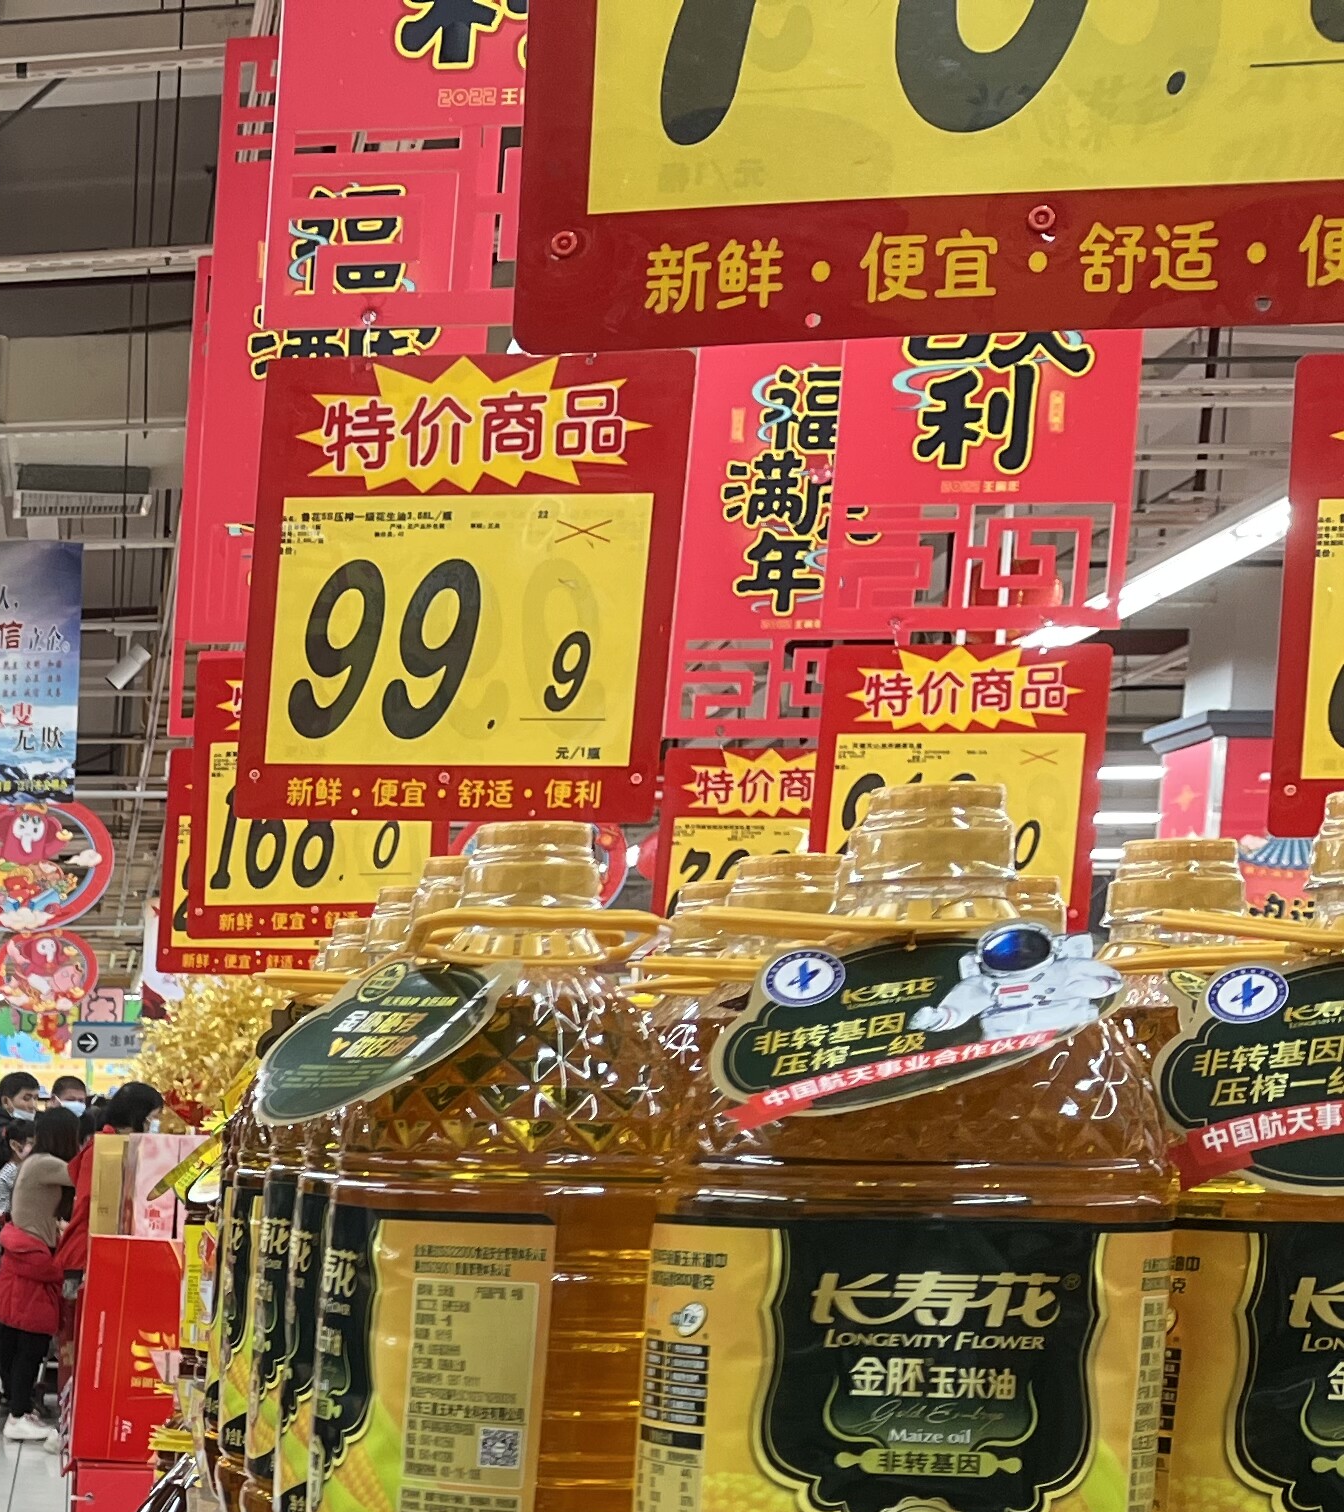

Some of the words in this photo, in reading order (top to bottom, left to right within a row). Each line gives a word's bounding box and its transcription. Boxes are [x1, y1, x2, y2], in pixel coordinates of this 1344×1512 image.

[438, 87, 497, 108] 2022
[501, 87, 526, 106] 壬
[321, 386, 627, 472] 特价商品
[863, 666, 1069, 718] 特价商品
[753, 1011, 905, 1057] 非转基因
[771, 1031, 927, 1078] 压榨一级
[1193, 1036, 1344, 1077] 非转基因
[761, 1028, 1056, 1108] 中国航天事业合作伙伴
[1201, 1103, 1344, 1154] 中国航天事
[811, 1271, 1062, 1327] 长寿花
[823, 1328, 951, 1351] LONGEVITY
[953, 1330, 1045, 1351] FLOWER
[849, 1356, 1016, 1400] 金胚玉米油
[888, 1427, 943, 1444] Maize
[946, 1428, 972, 1445] oil
[877, 1451, 982, 1476] 非转基因
